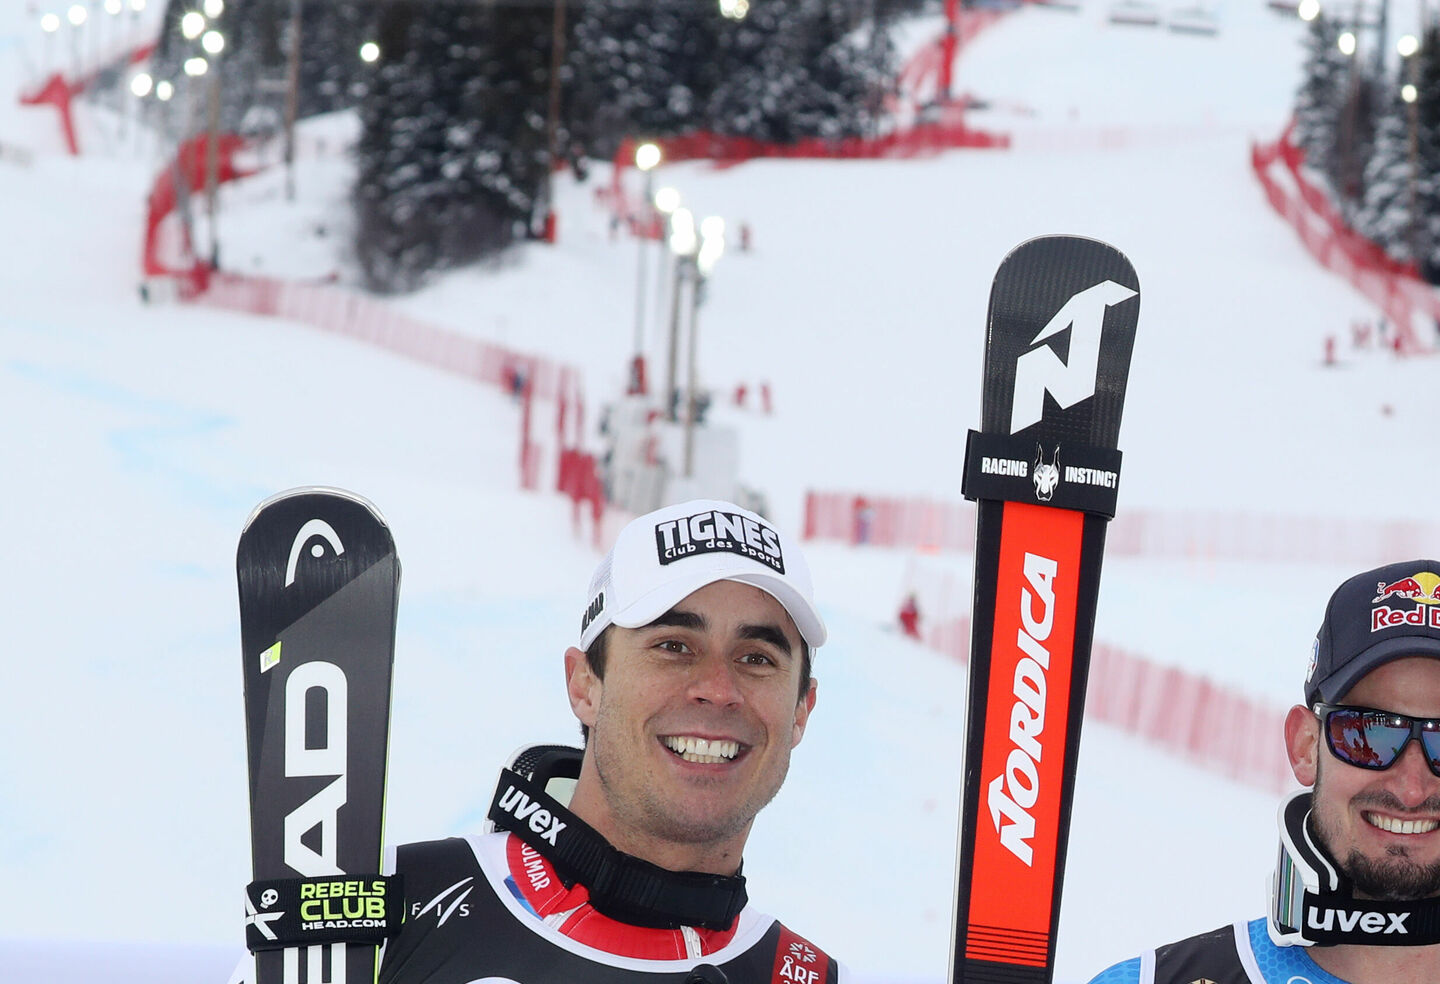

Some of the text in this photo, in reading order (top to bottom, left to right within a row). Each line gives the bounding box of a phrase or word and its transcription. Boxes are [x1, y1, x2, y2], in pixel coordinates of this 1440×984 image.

[982, 456, 1118, 490] RACING INSTINCT
[658, 511, 781, 559] TIGNES
[665, 539, 782, 569] Club des Sports
[1371, 604, 1424, 632] Red
[988, 551, 1058, 868] NORDICA
[498, 785, 568, 847] uvex
[301, 881, 386, 899] REBELS
[301, 897, 386, 921] CLUB
[1307, 906, 1412, 936] uvex
[302, 919, 387, 930] HEAD.COM
